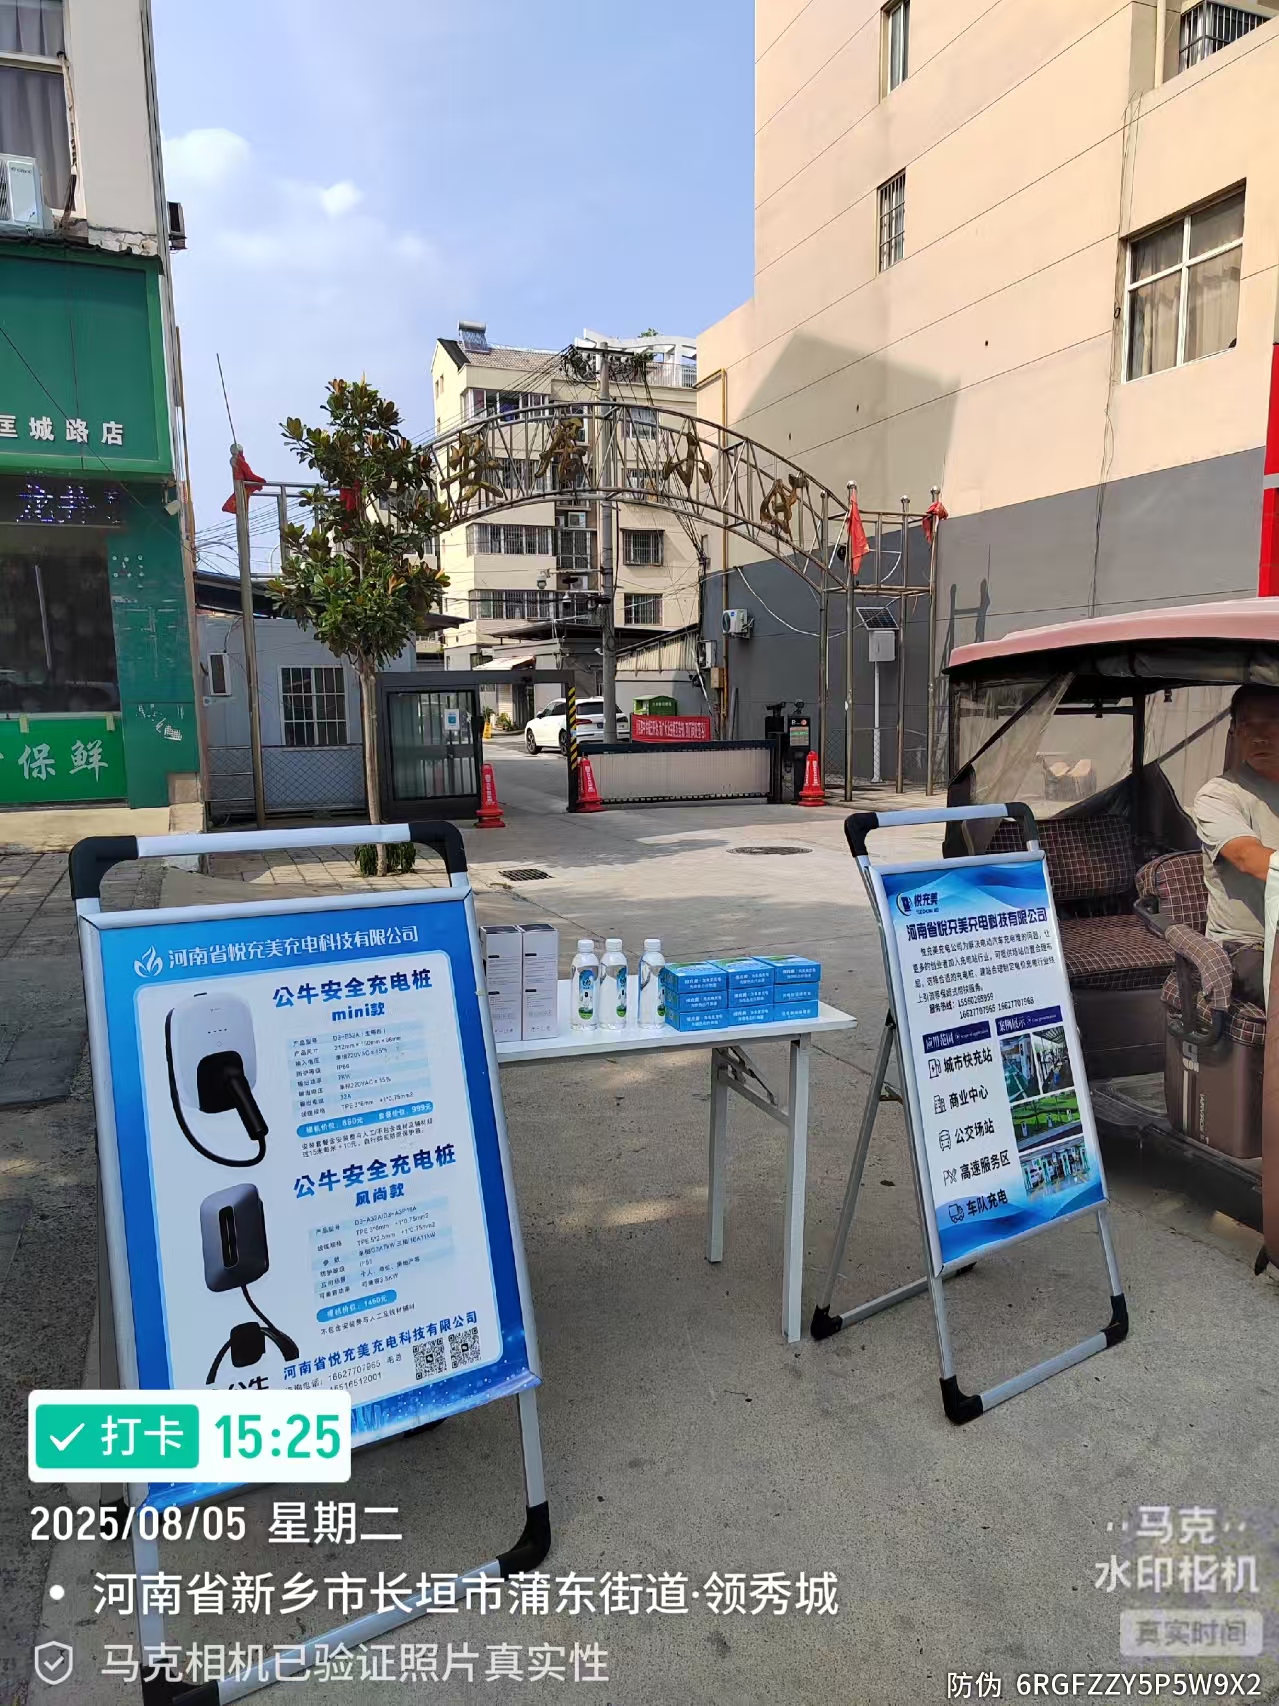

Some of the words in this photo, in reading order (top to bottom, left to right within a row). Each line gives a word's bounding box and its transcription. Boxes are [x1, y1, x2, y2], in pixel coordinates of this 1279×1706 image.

[0, 739, 109, 783] 保鲜
[913, 892, 939, 907] 悦充美
[906, 907, 1048, 941] 河南省悦充美充电科技有限公司
[168, 925, 420, 969] 河南省悦充美充电科技有限公司
[272, 968, 433, 1008] 公牛安全充电桩
[331, 1001, 386, 1022] mini款
[943, 1047, 993, 1074] 城市快充站
[948, 1084, 989, 1111] 商业中心
[954, 1118, 995, 1145] 公交场站
[293, 1143, 457, 1199] 公牛安全充电桩
[959, 1150, 1011, 1181] 高速服务区
[355, 1182, 405, 1208] 风尚款
[966, 1188, 1009, 1217] 车队充电
[283, 1310, 478, 1381] 河南省悦充美充电科技有限公司
